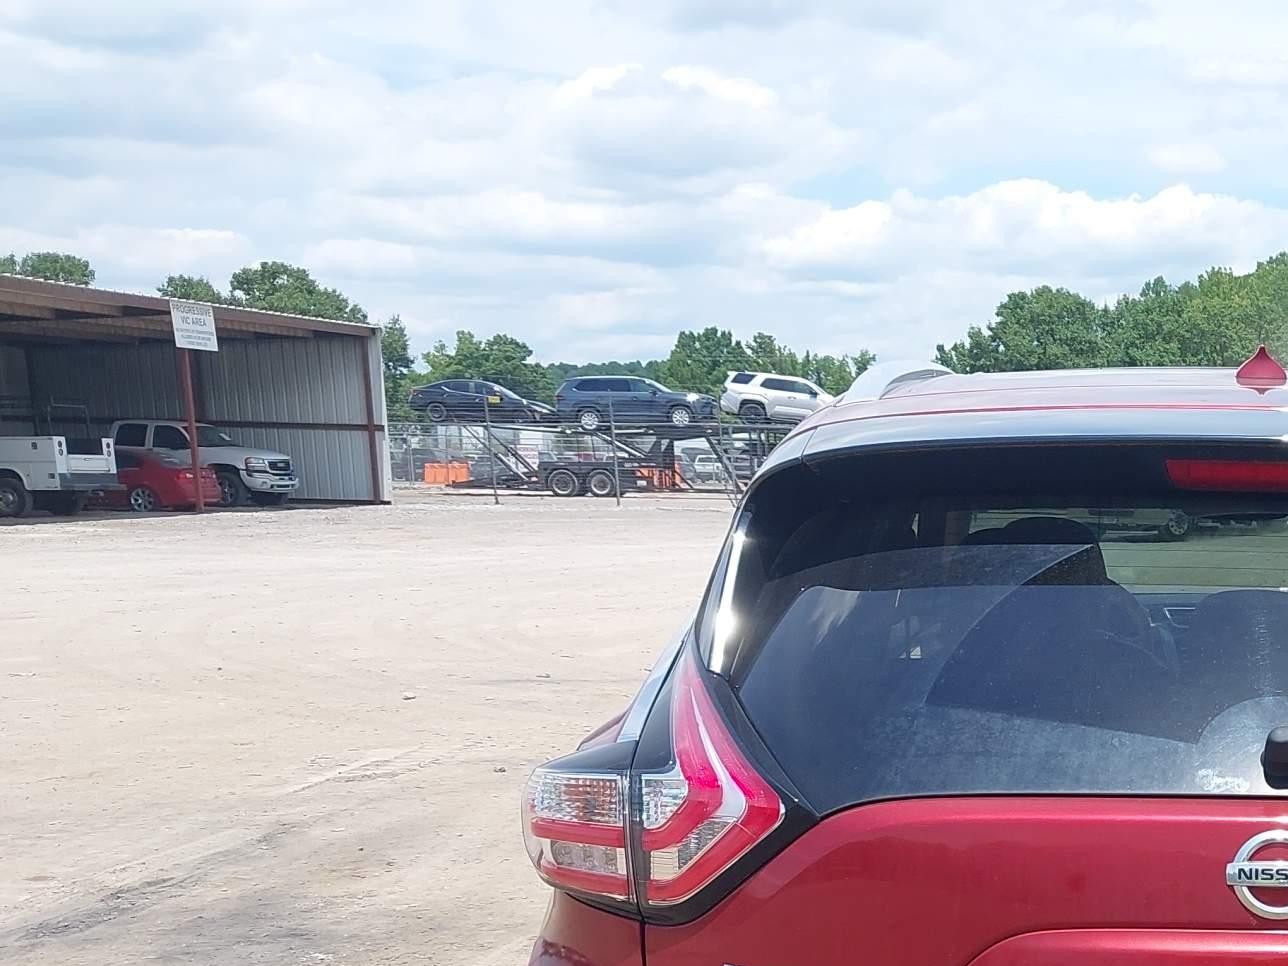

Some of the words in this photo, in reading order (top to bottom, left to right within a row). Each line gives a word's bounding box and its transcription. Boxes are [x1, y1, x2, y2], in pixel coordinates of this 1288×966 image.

[171, 302, 213, 318] PROGRESSIVE
[181, 315, 191, 326] VIC
[192, 317, 207, 327] AREA
